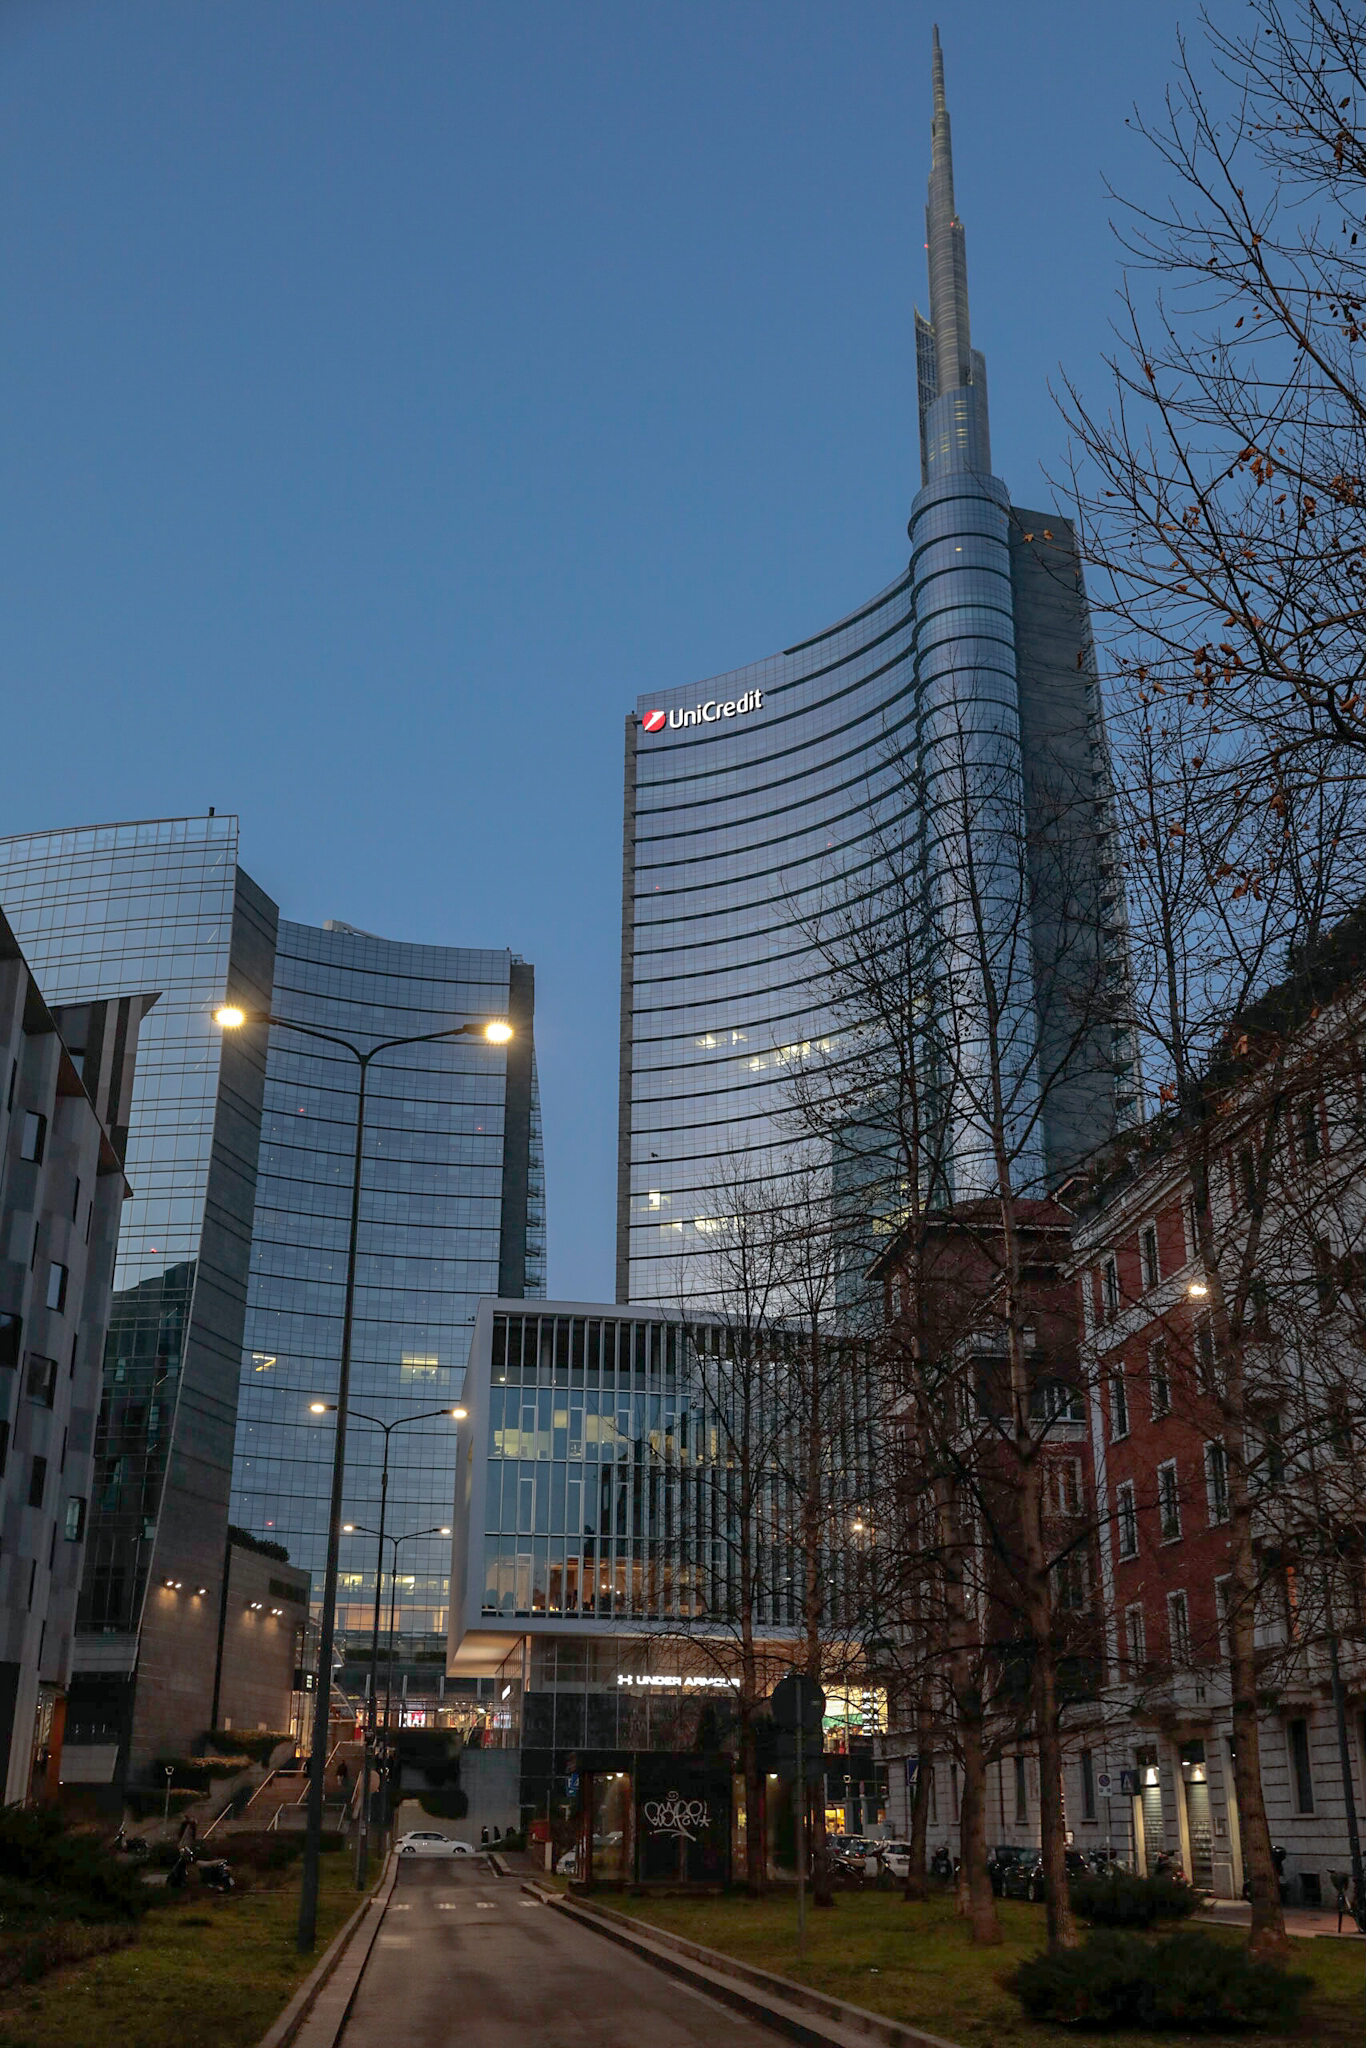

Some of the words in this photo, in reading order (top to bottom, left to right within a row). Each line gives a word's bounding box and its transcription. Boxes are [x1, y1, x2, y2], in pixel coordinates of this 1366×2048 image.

[669, 688, 762, 729] UniCredit
[636, 1675, 682, 1686] UNDER
[683, 1676, 741, 1688] ARMOUR
